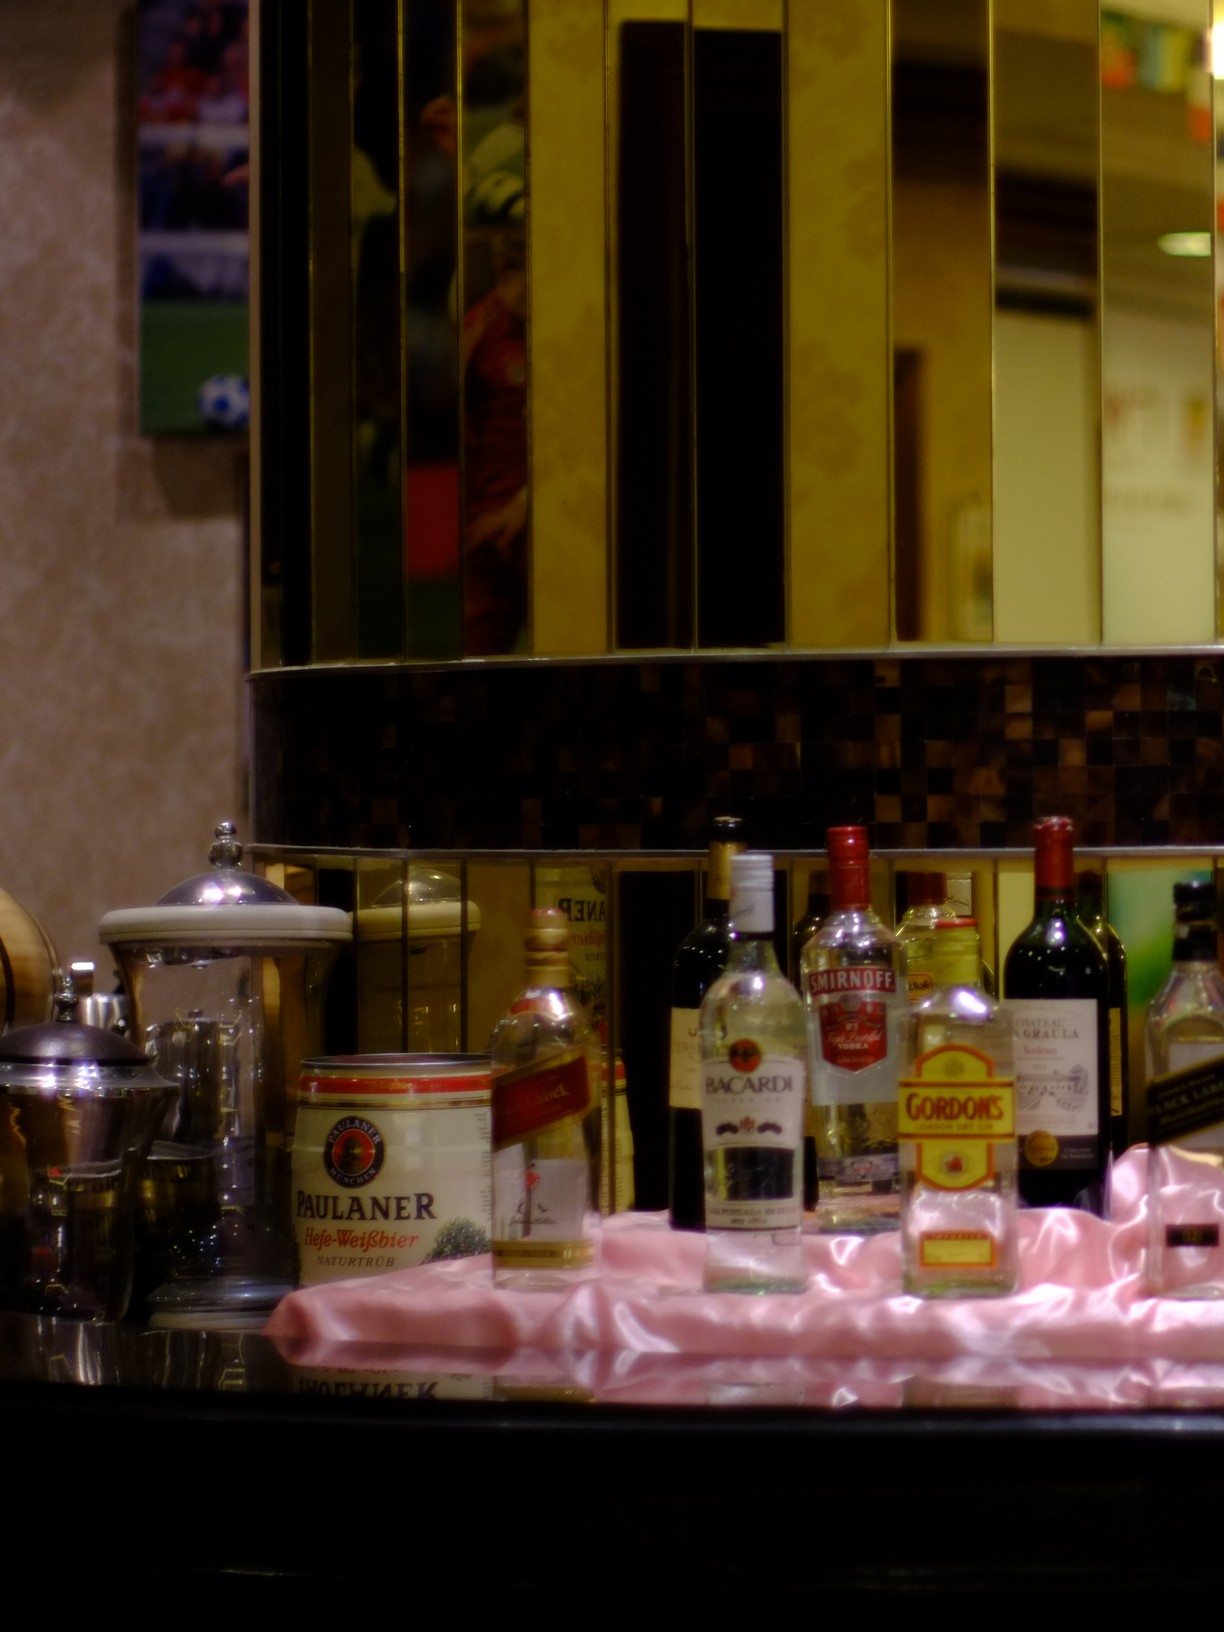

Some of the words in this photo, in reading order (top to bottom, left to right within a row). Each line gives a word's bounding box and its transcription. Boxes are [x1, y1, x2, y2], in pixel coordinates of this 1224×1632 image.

[809, 969, 893, 993] SMIRNOFF
[705, 1074, 793, 1095] BACARDI
[327, 1118, 382, 1145] PAULANER
[327, 1166, 378, 1186] MÜNCHEN
[296, 1189, 438, 1220] PAULANER
[304, 1226, 419, 1253] Hefe-Weißbier
[316, 1254, 395, 1267] NATURTRÜB
